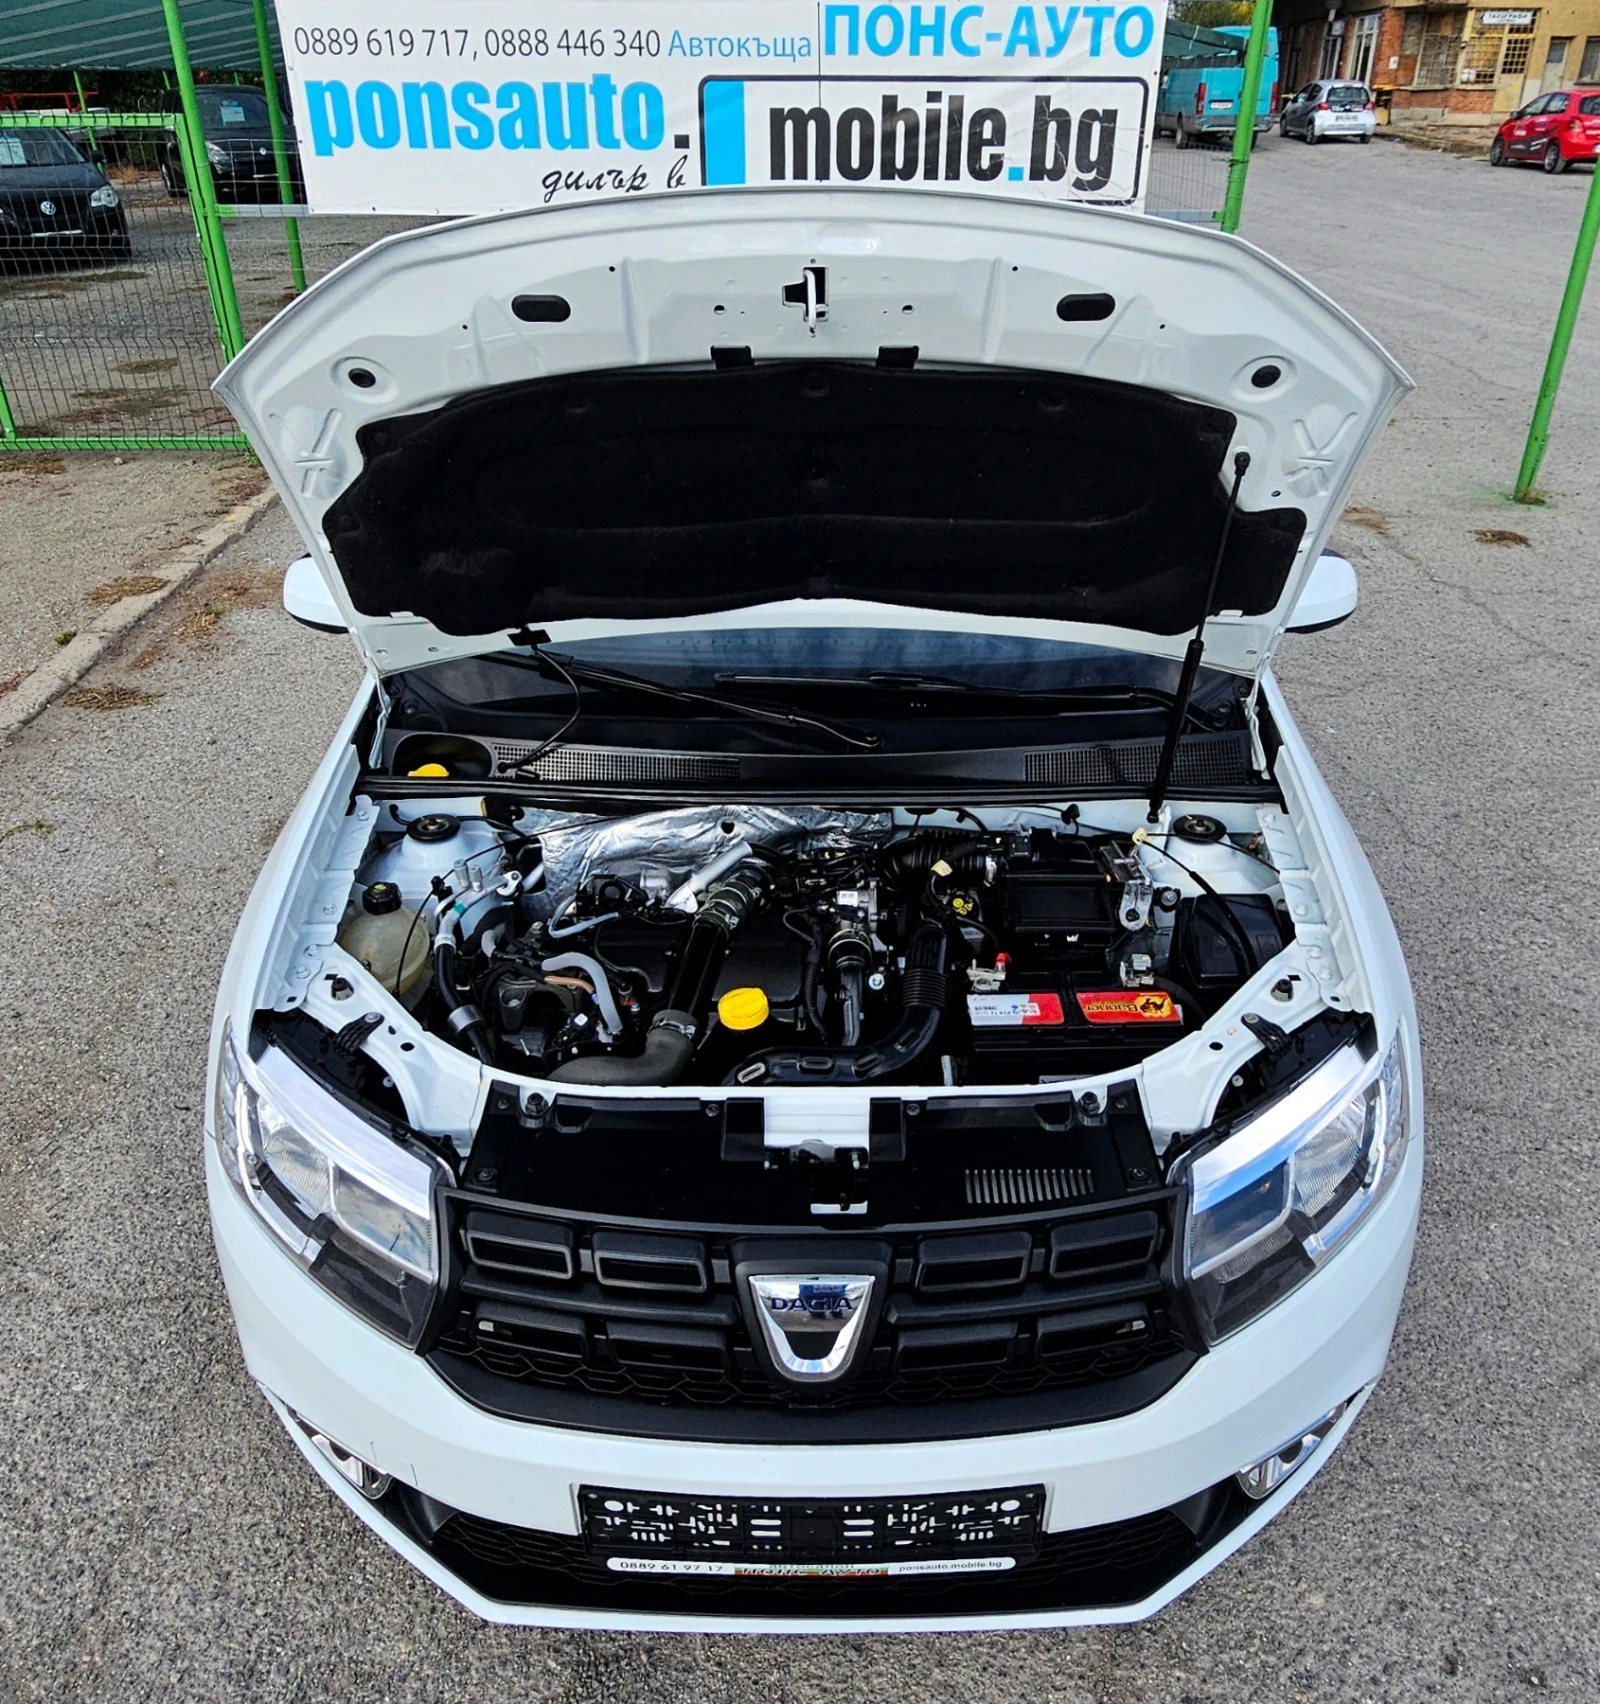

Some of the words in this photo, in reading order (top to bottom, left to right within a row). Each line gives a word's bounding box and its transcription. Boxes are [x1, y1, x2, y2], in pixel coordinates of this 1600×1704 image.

[823, 4, 1155, 58] ПОНС-АУТО
[294, 27, 358, 57] 0889
[366, 28, 415, 57] 619
[421, 29, 478, 61] 717,
[484, 29, 550, 57] 0888
[556, 29, 605, 57] 446
[613, 29, 661, 57] 340
[667, 30, 812, 63] Автокъща
[769, 90, 1119, 192] mobile.bg
[1086, 1003, 1138, 1012] Banner
[771, 1297, 853, 1311] DACIA
[620, 1561, 656, 1570] 0889
[661, 1563, 677, 1571] 61
[899, 1561, 1003, 1573] ponsauto.mobile.bg
